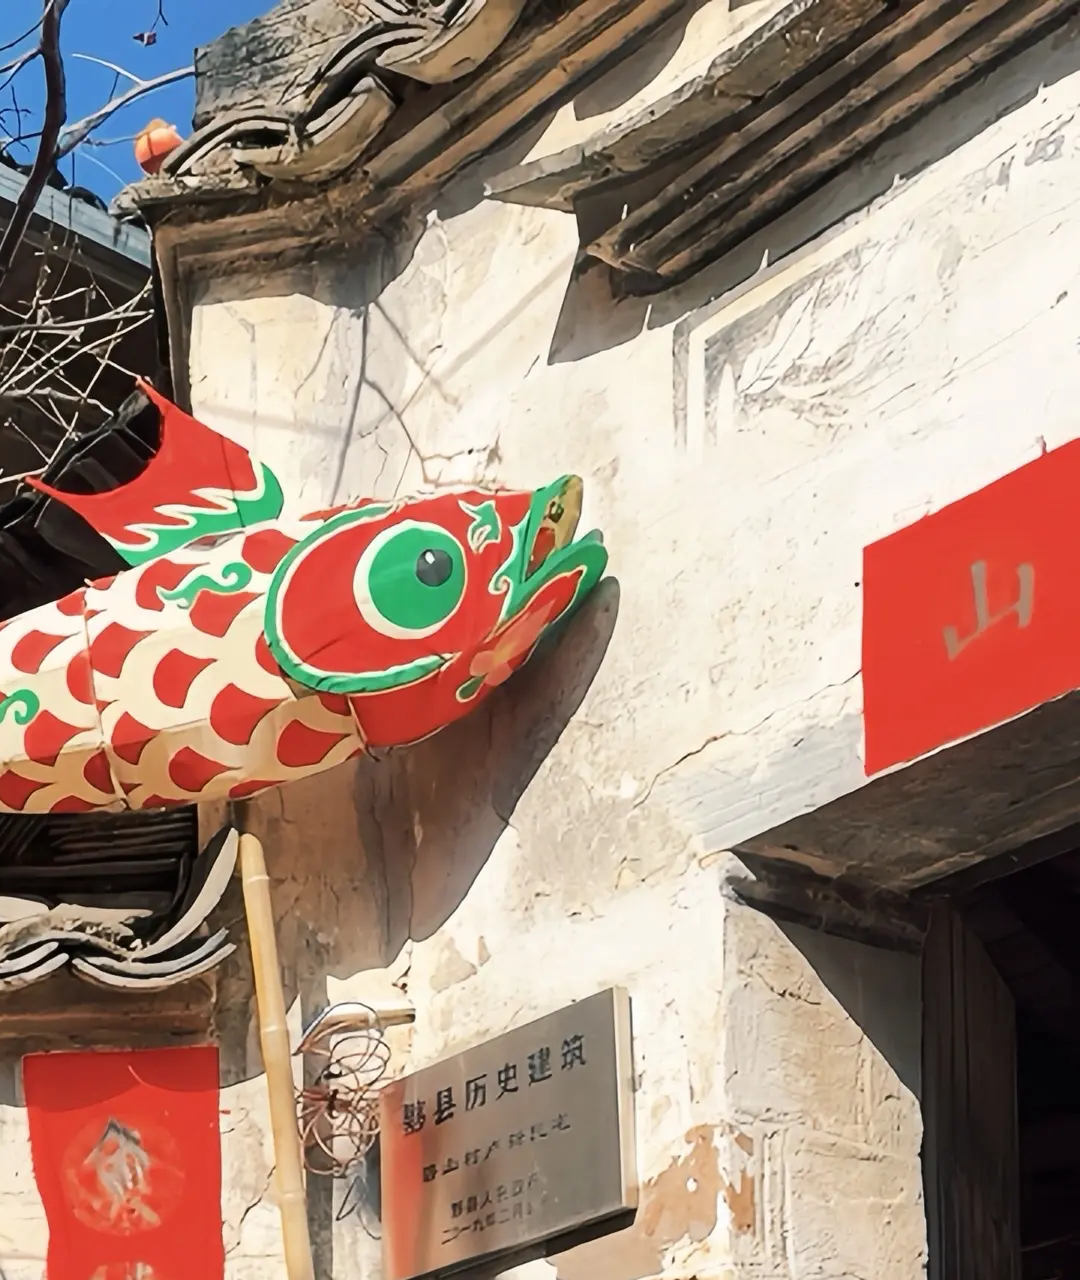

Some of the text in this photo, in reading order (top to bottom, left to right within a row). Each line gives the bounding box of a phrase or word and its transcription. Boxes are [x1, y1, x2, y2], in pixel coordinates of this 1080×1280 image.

[401, 1034, 587, 1135] 黟县历史建筑
